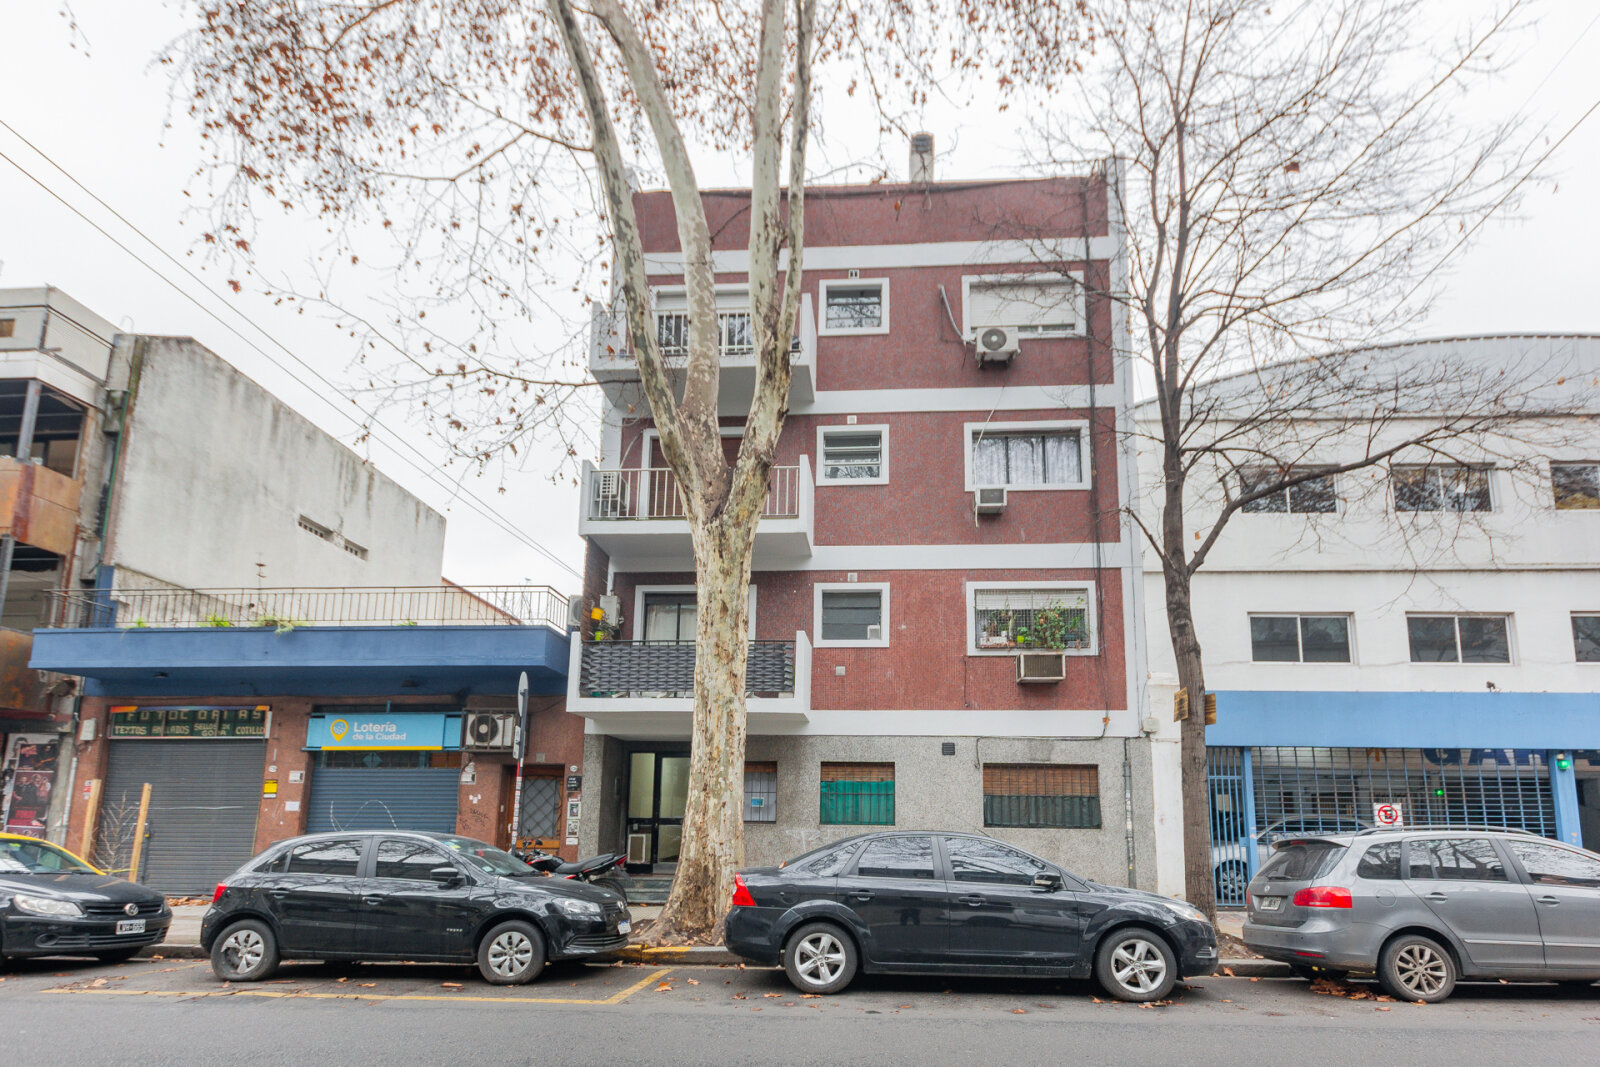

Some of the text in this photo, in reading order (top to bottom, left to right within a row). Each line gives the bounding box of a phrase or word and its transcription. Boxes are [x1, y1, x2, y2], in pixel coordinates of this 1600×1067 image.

[115, 725, 147, 735] TEXTOS
[353, 721, 397, 732] Lotería
[375, 732, 407, 740] Ciudad
